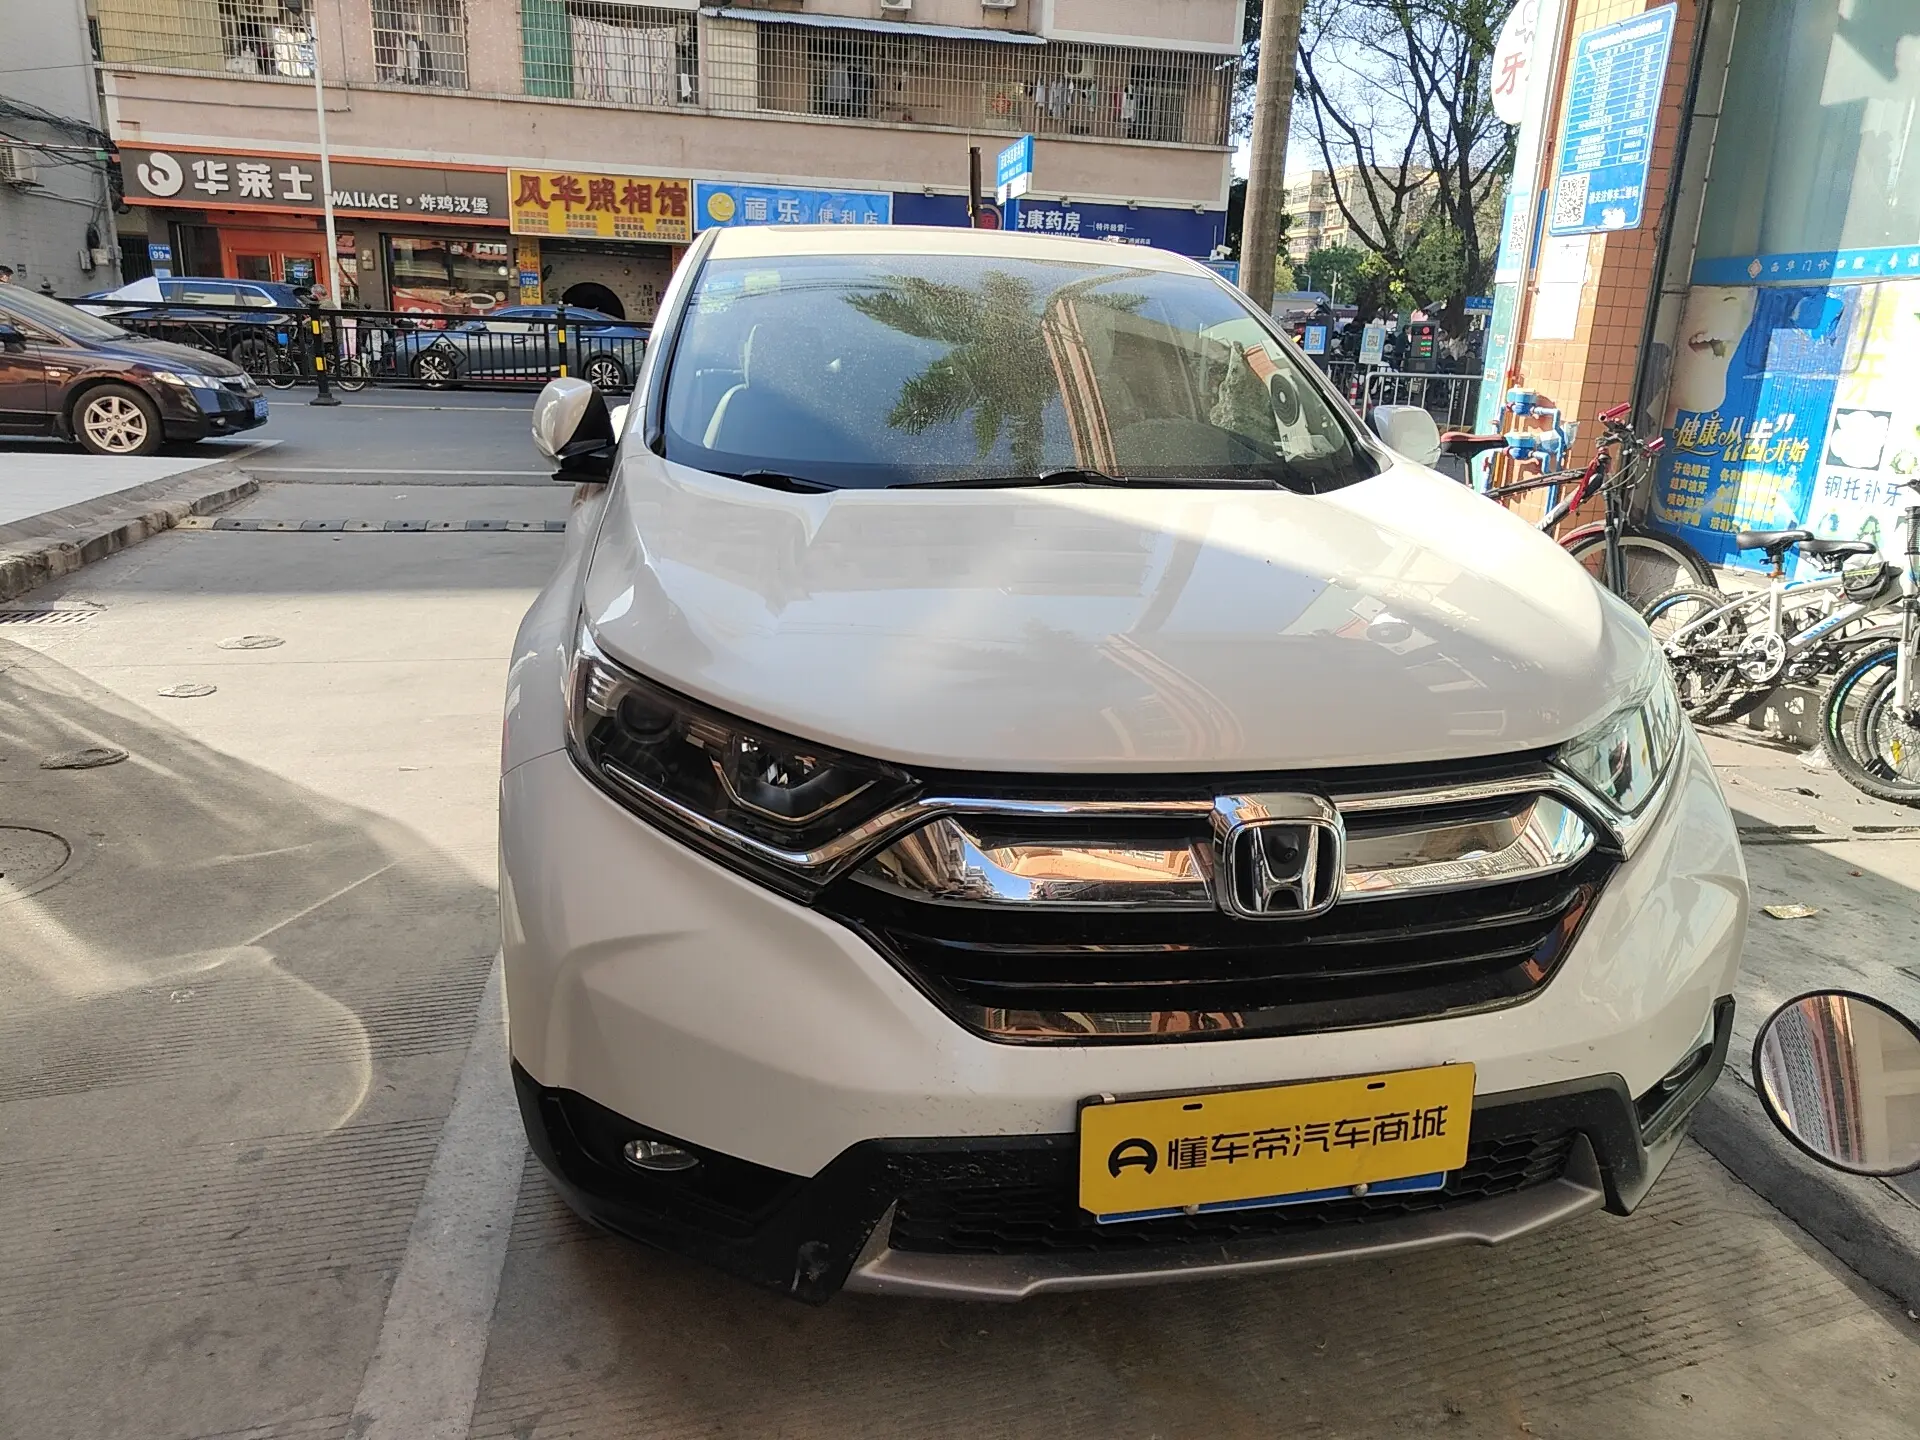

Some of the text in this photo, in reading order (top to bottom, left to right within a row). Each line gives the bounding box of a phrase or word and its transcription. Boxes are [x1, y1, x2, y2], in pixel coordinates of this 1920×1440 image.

[192, 160, 313, 200] 华莱士
[514, 174, 688, 217] 风华照相馆
[332, 190, 399, 209] WALLACE
[419, 193, 489, 214] 炸鸡汉堡
[745, 197, 879, 224] 福乐 便利店
[1825, 475, 1902, 507] 钢托补牙
[1167, 1104, 1450, 1171] 懂车帝汽车商城
